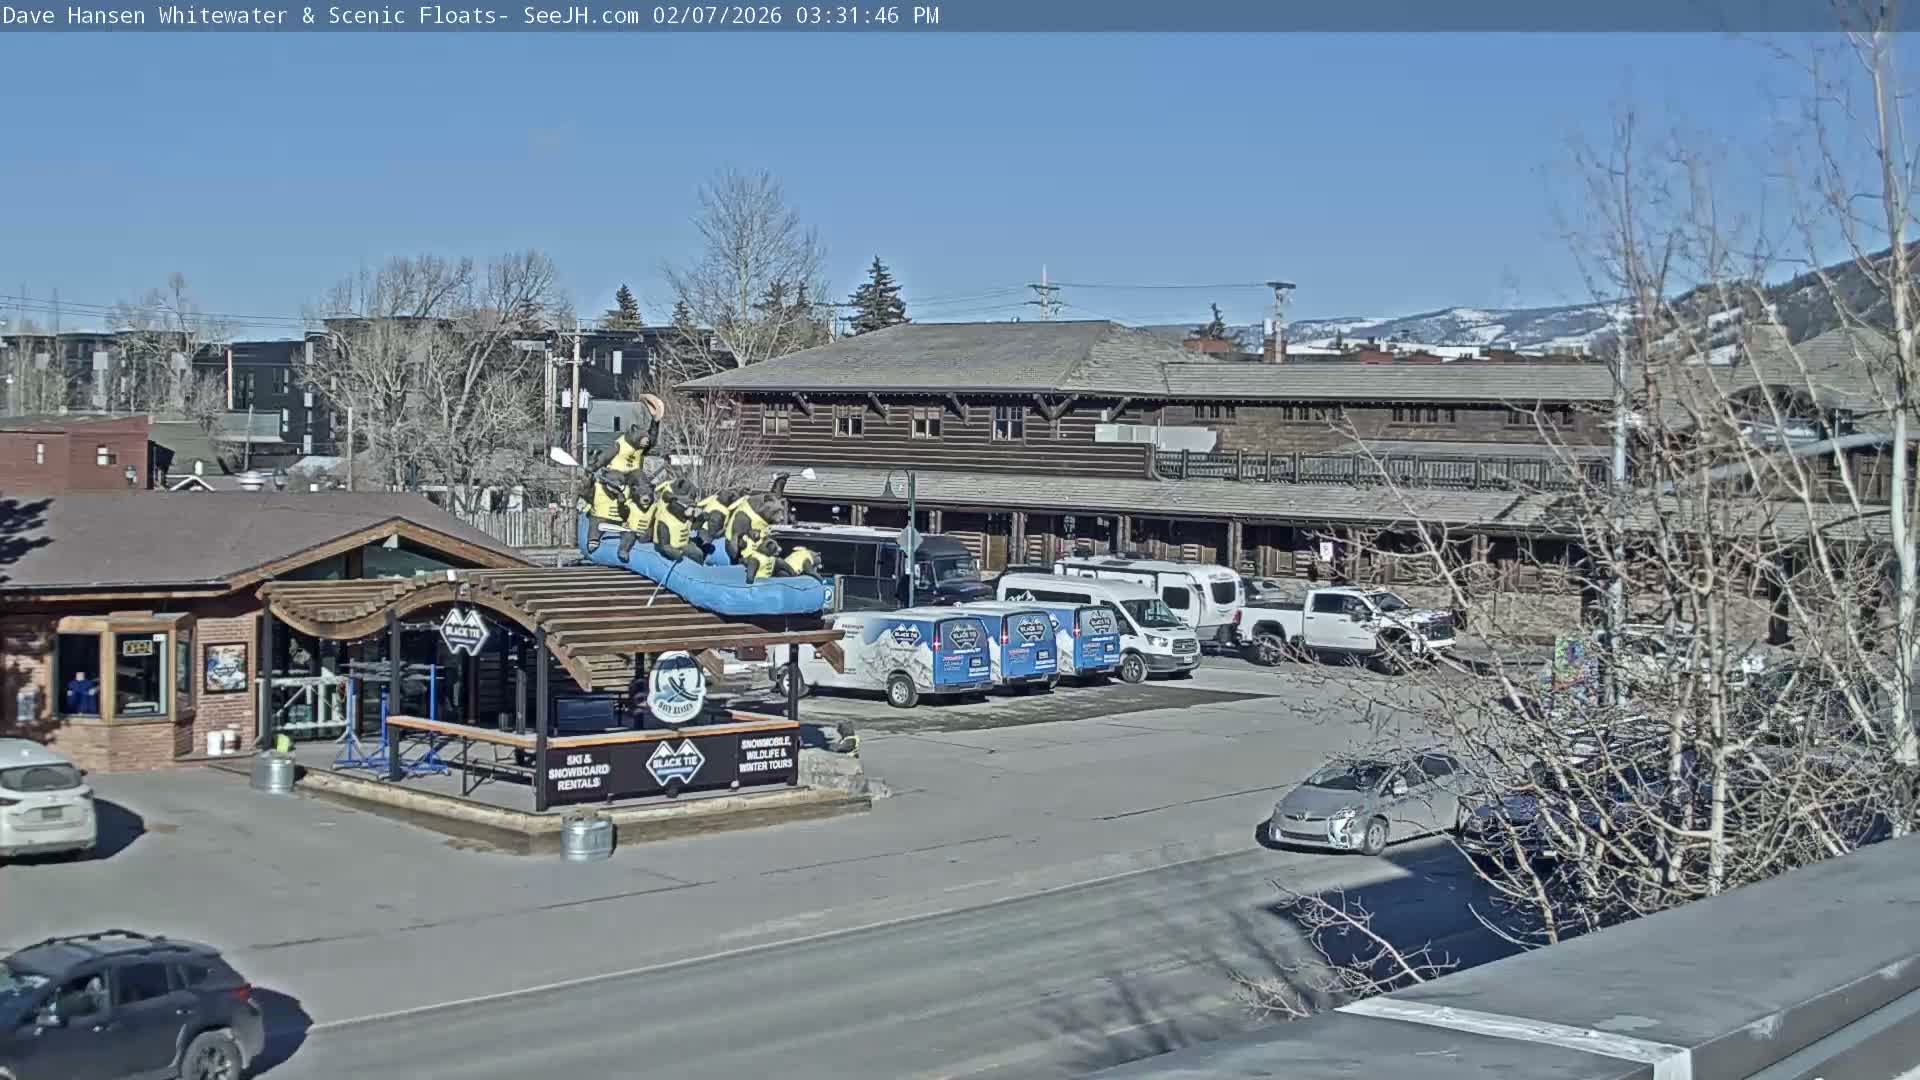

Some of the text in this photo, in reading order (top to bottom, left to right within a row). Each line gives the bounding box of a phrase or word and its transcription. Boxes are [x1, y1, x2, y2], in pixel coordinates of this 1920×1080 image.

[566, 753, 592, 766] SKI &
[652, 755, 698, 769] BLACK TIE
[746, 749, 780, 761] WILDLIFE
[548, 763, 610, 780] SNOWBOARD
[739, 758, 793, 773] WINTER TOURS
[557, 776, 601, 792] RENTALS
